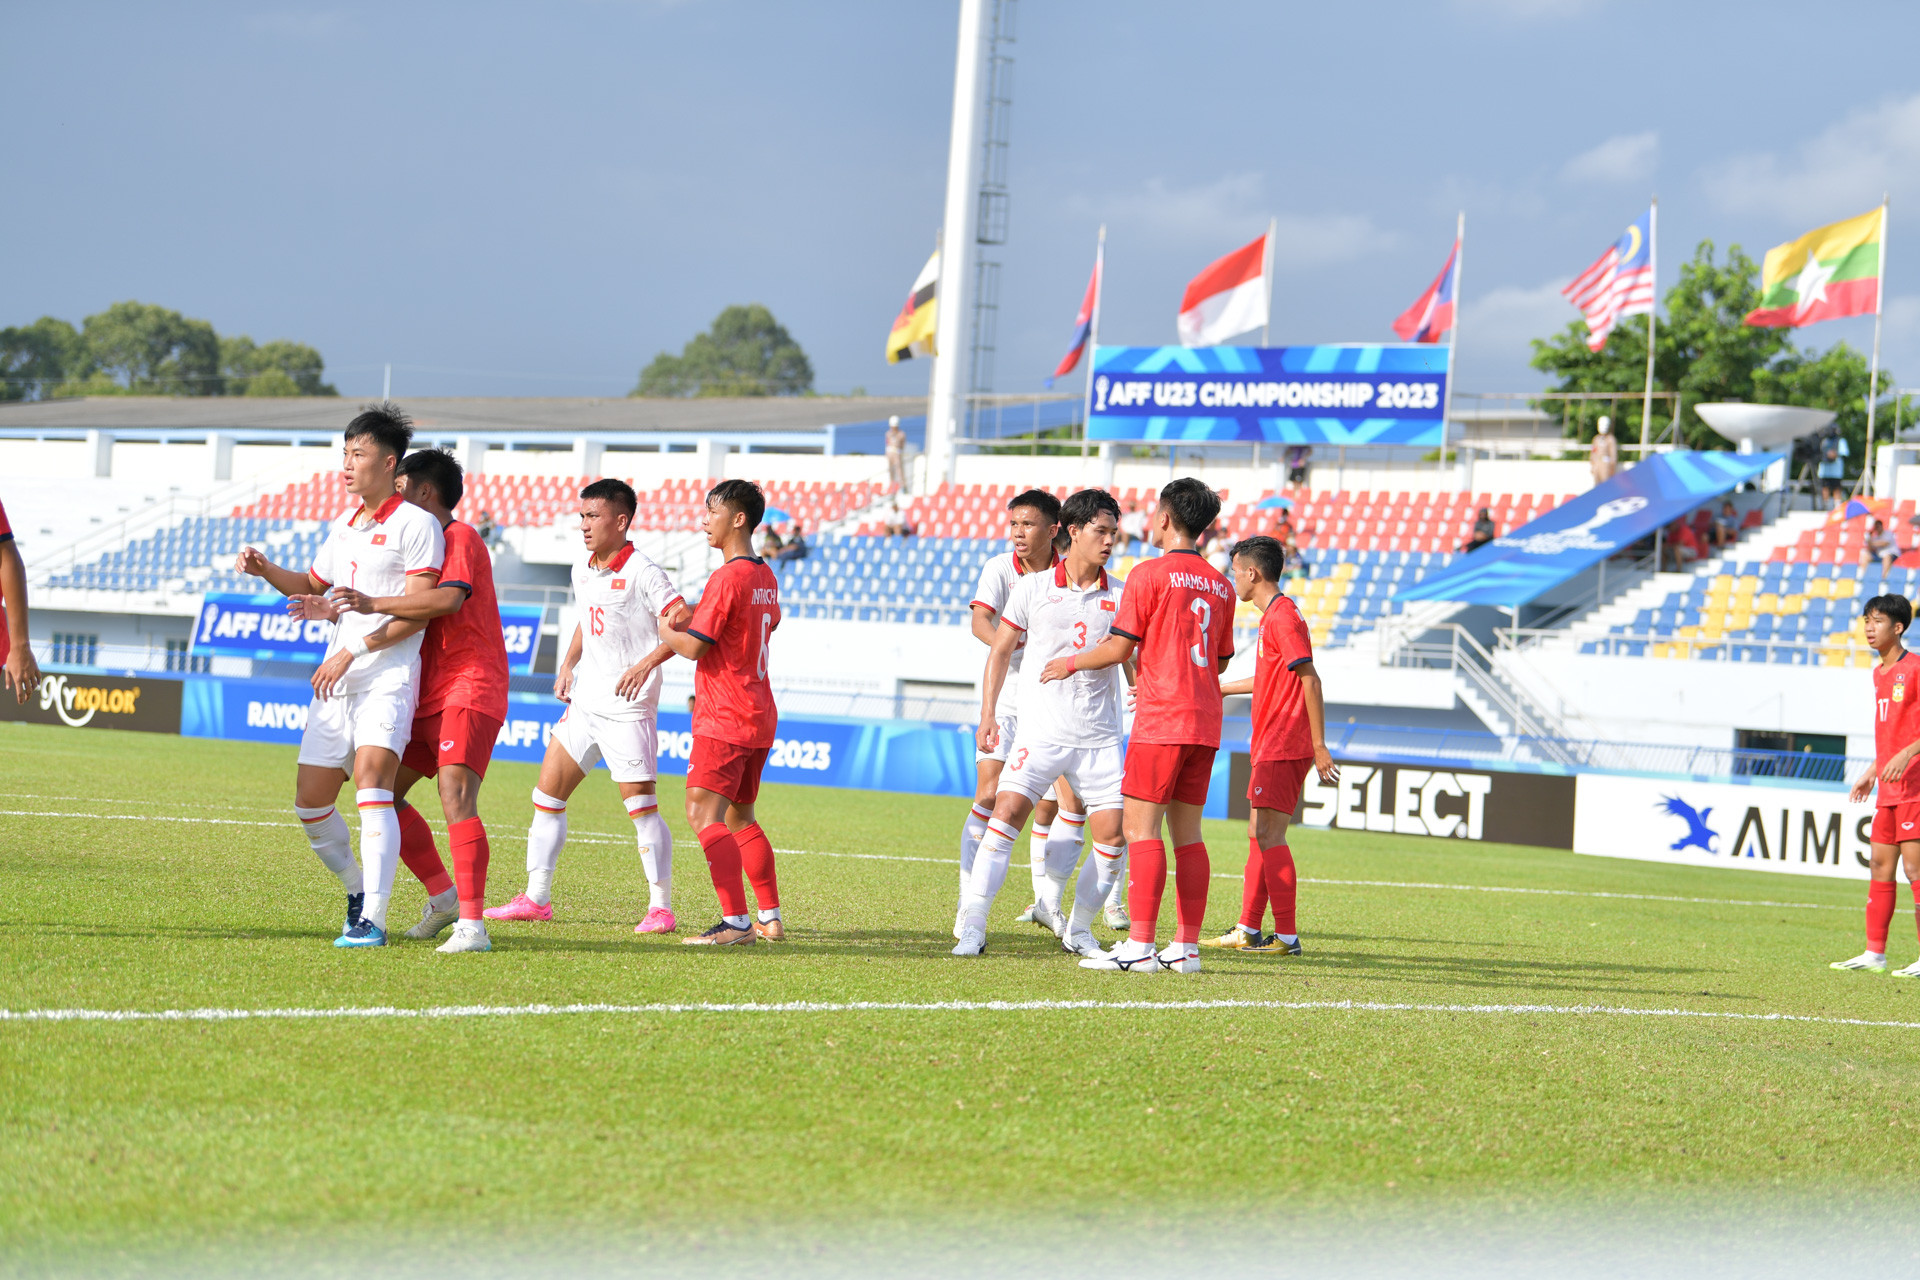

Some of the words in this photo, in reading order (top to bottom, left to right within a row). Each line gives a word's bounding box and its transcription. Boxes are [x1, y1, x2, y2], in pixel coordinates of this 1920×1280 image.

[1108, 381, 1153, 406] AFF
[1154, 381, 1198, 407] U23
[1199, 381, 1374, 408] CHAMPIONSHIP
[1376, 382, 1439, 409] 2023
[1168, 571, 1210, 593] KHAMSA
[214, 611, 260, 639] AFF
[260, 613, 301, 642] U23
[501, 624, 533, 654] 23
[589, 606, 605, 637] 15
[1073, 621, 1087, 650] 3
[1190, 597, 1211, 668] 3
[756, 612, 772, 682] 6
[1877, 698, 1889, 722] 17
[495, 719, 540, 748] AFF
[769, 739, 831, 770] 2023
[1010, 747, 1029, 771] 3
[1302, 764, 1492, 840] SELECT
